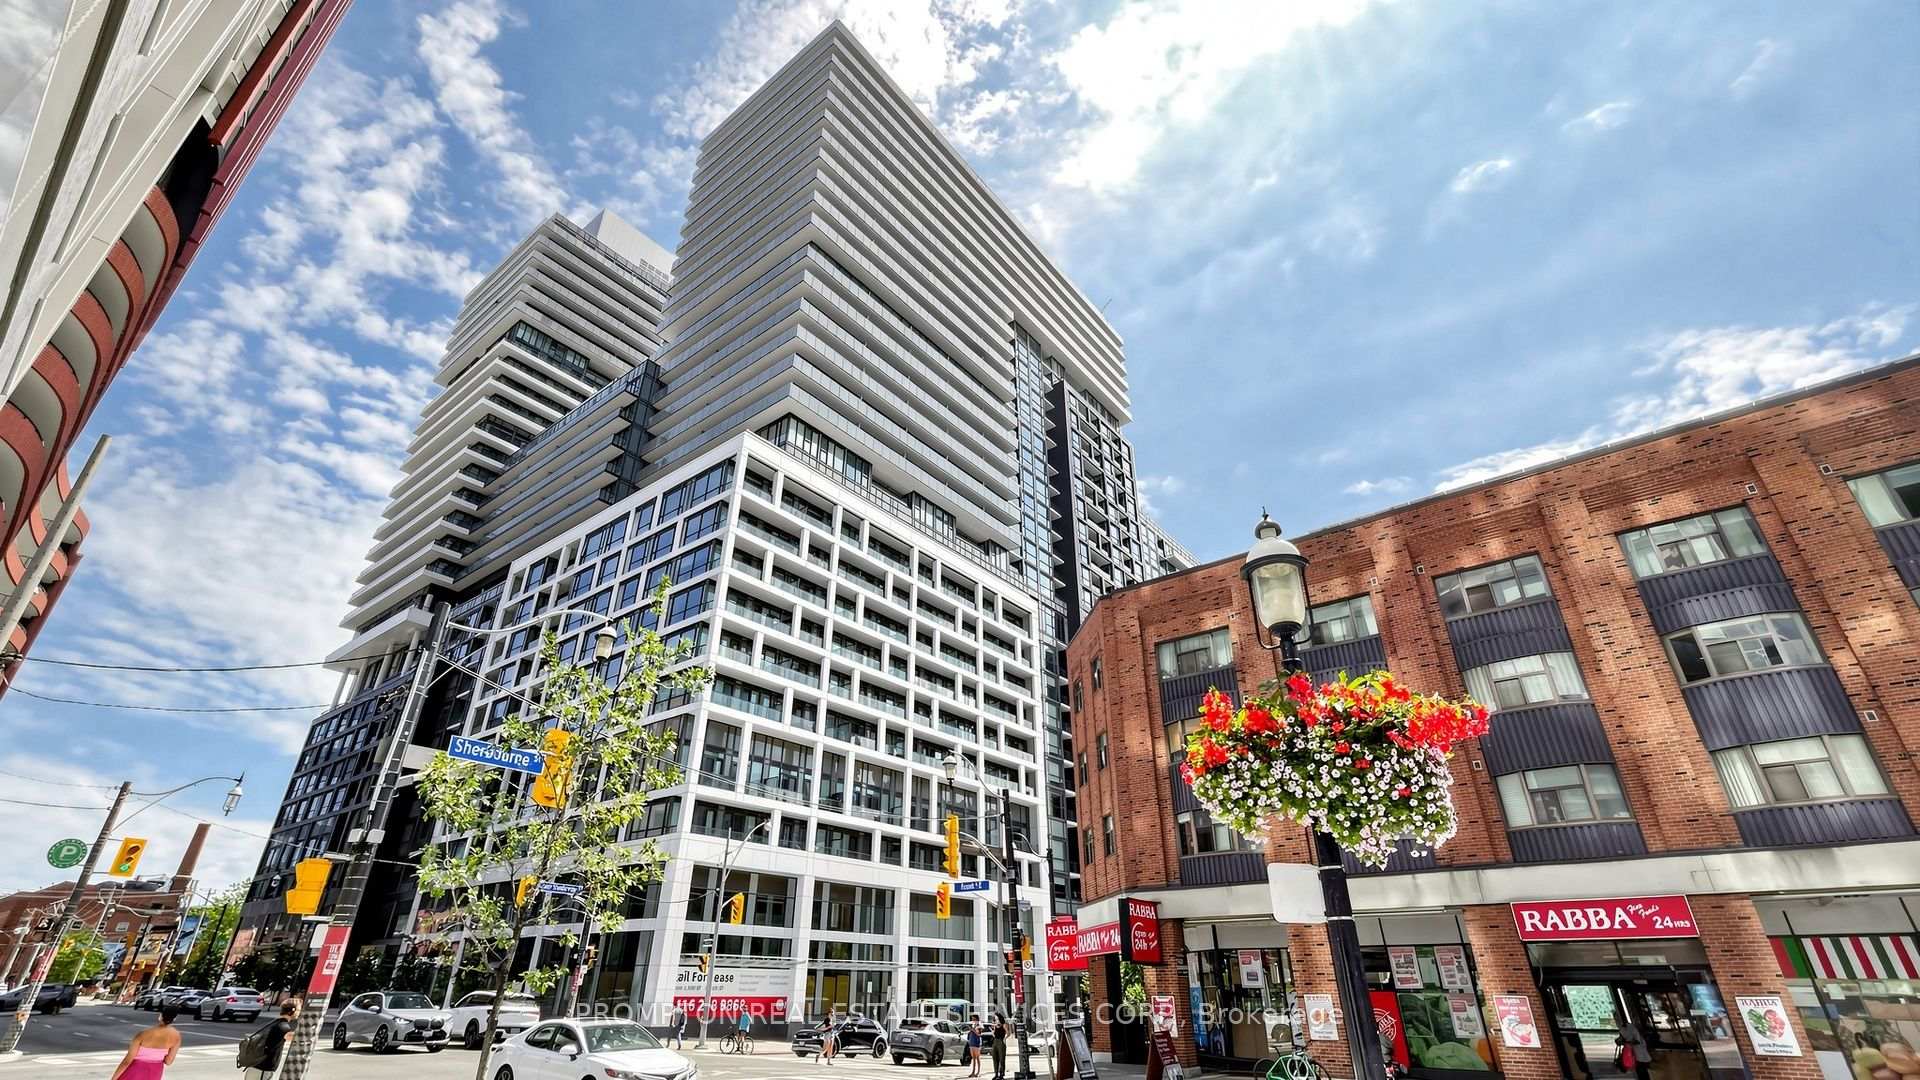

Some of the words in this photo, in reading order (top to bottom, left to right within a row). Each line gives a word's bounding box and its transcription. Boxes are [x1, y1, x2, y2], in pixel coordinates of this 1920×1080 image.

[454, 739, 530, 767] Sherbourne
[1129, 903, 1157, 919] RABBA
[1520, 906, 1638, 932] RABBA
[1652, 915, 1674, 929] 24
[1047, 925, 1077, 937] RABB
[1078, 931, 1102, 954] RABBA
[1053, 951, 1070, 961] 24h
[691, 971, 707, 982] For
[713, 975, 735, 983] ease
